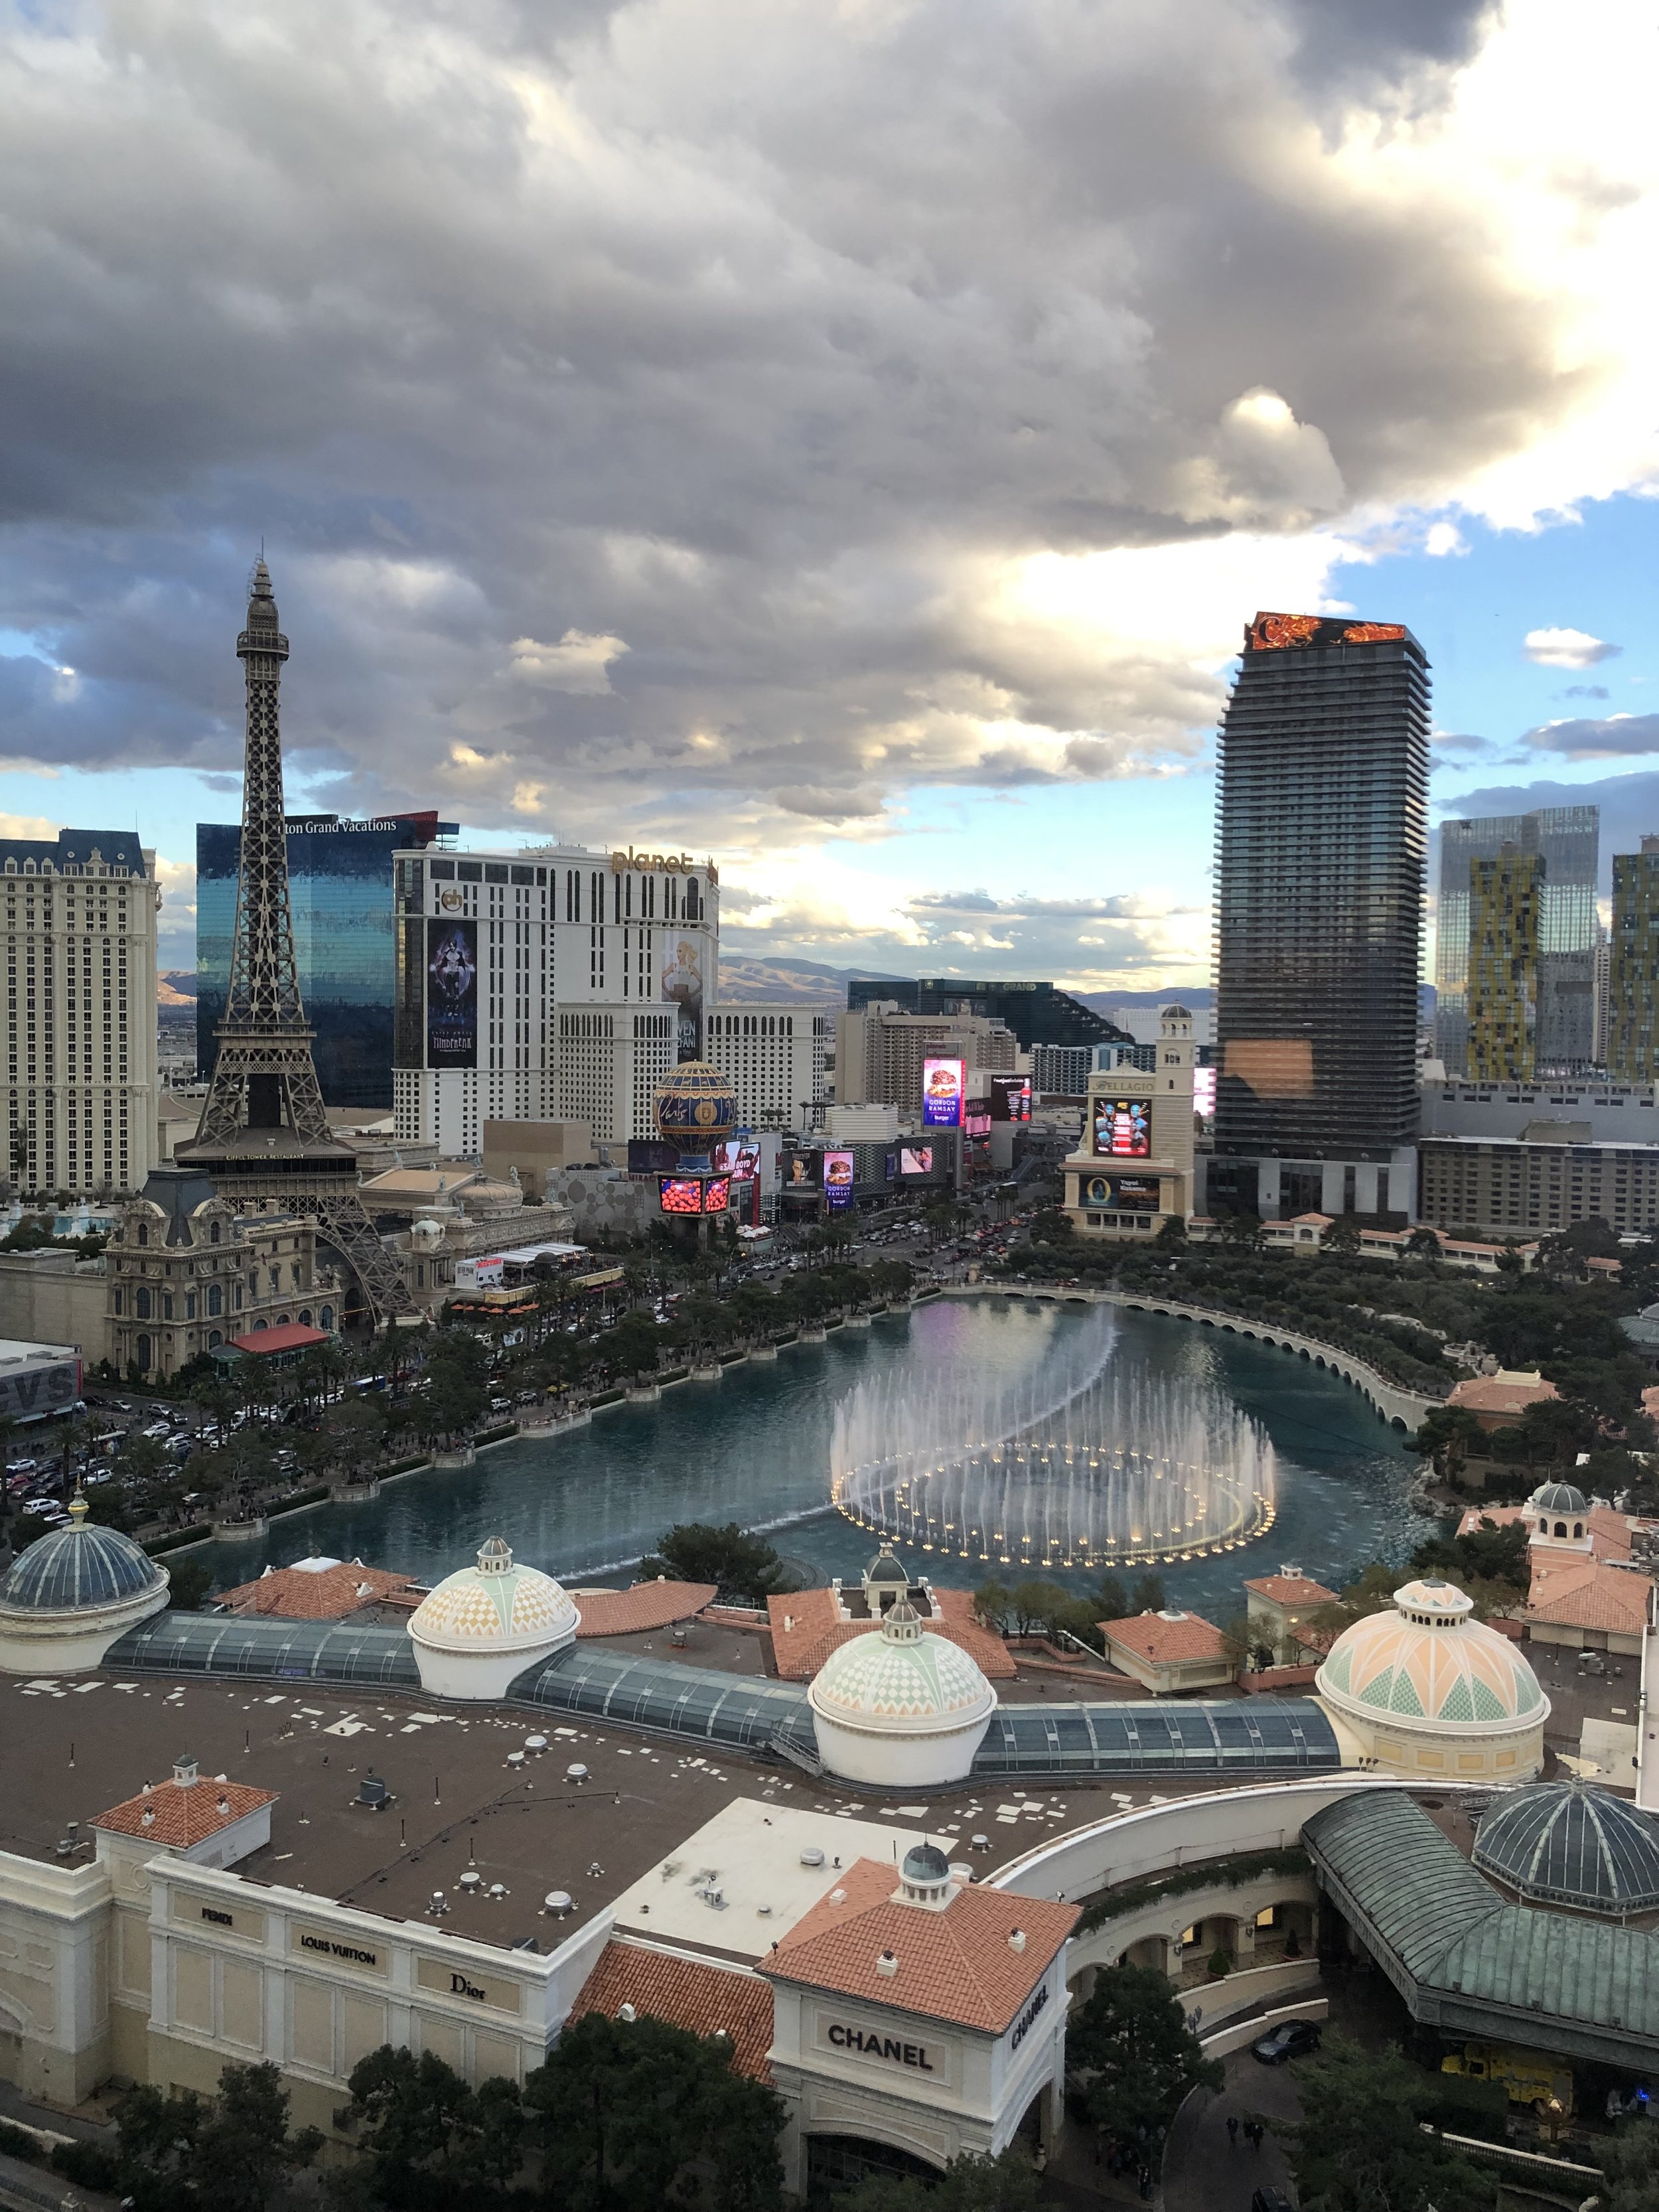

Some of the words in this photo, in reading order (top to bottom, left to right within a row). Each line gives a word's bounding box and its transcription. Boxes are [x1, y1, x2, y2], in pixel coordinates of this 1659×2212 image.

[305, 819, 339, 834] Grand
[342, 818, 397, 832] Vacations
[612, 845, 693, 875] planet
[443, 889, 463, 910] ph
[1003, 982, 1037, 992] GRAND
[1092, 1080, 1153, 1091] BELLAGIO
[658, 1092, 688, 1130] Paris
[0, 1367, 73, 1412] VS
[201, 1907, 233, 1926] FENDI
[301, 1935, 331, 1953] LOUIS
[331, 1943, 376, 1965] VUITTON
[450, 1972, 486, 2000] Dior
[1011, 1984, 1049, 2050] CHANEL
[828, 2024, 933, 2071] CHANEL
